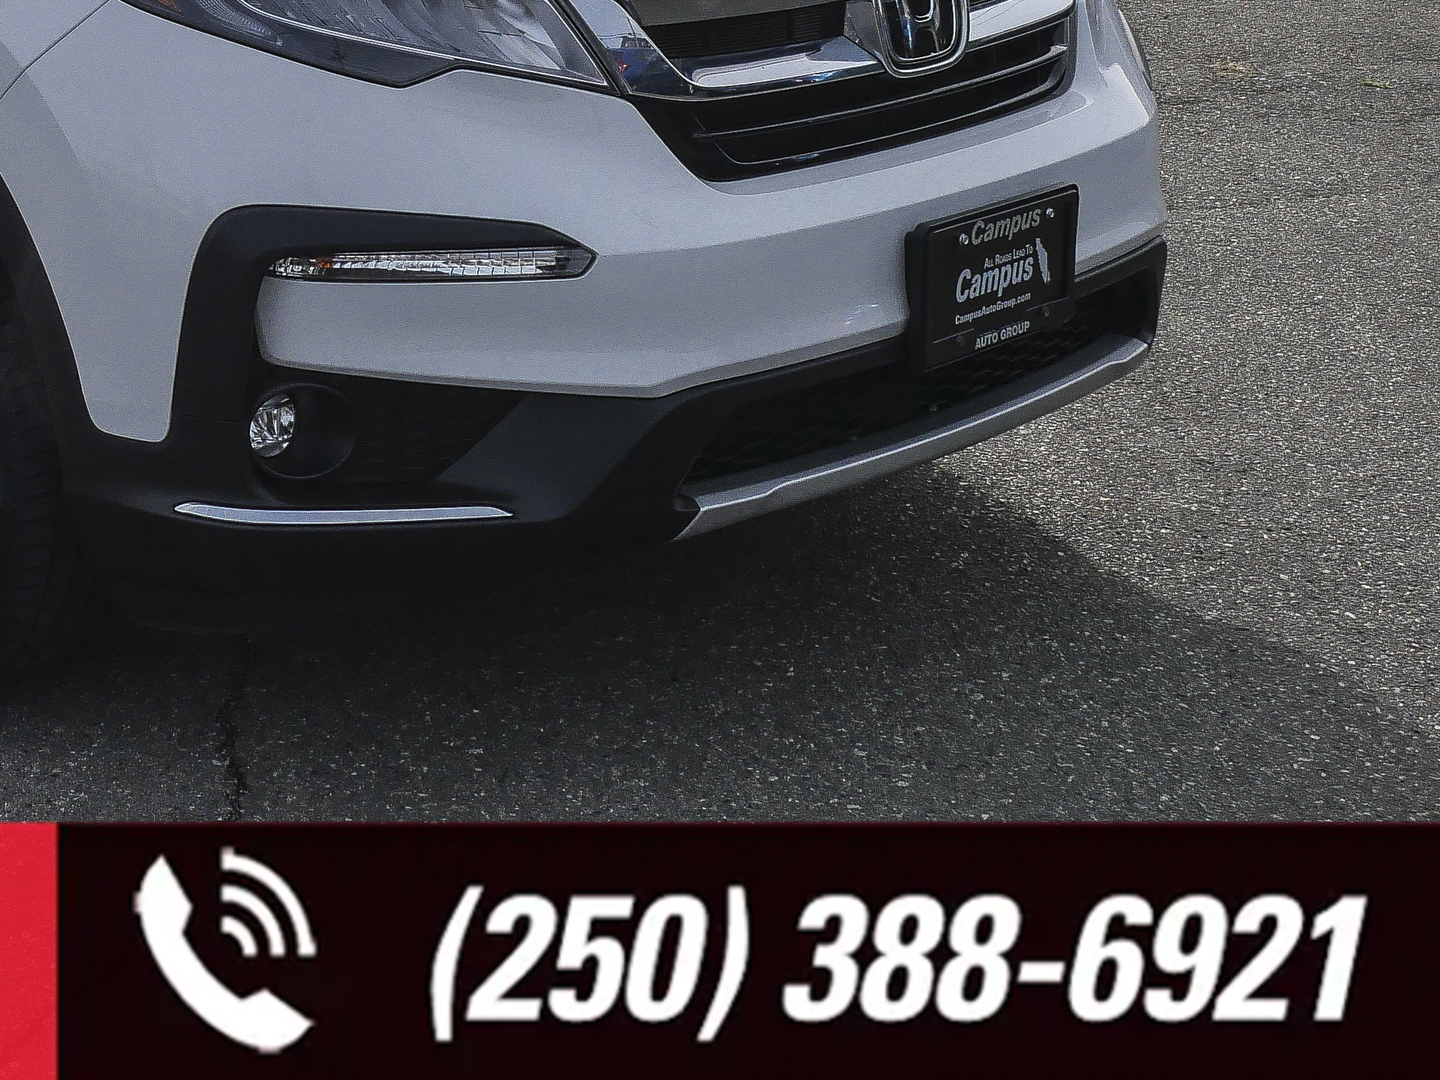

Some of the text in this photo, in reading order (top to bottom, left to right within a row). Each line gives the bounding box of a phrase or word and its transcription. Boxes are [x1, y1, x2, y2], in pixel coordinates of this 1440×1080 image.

[971, 209, 1041, 246] Campus
[955, 256, 1034, 304] Campus
[955, 292, 1031, 325] CampusAutoGroup.com
[975, 320, 1031, 350] AUTO GROUP
